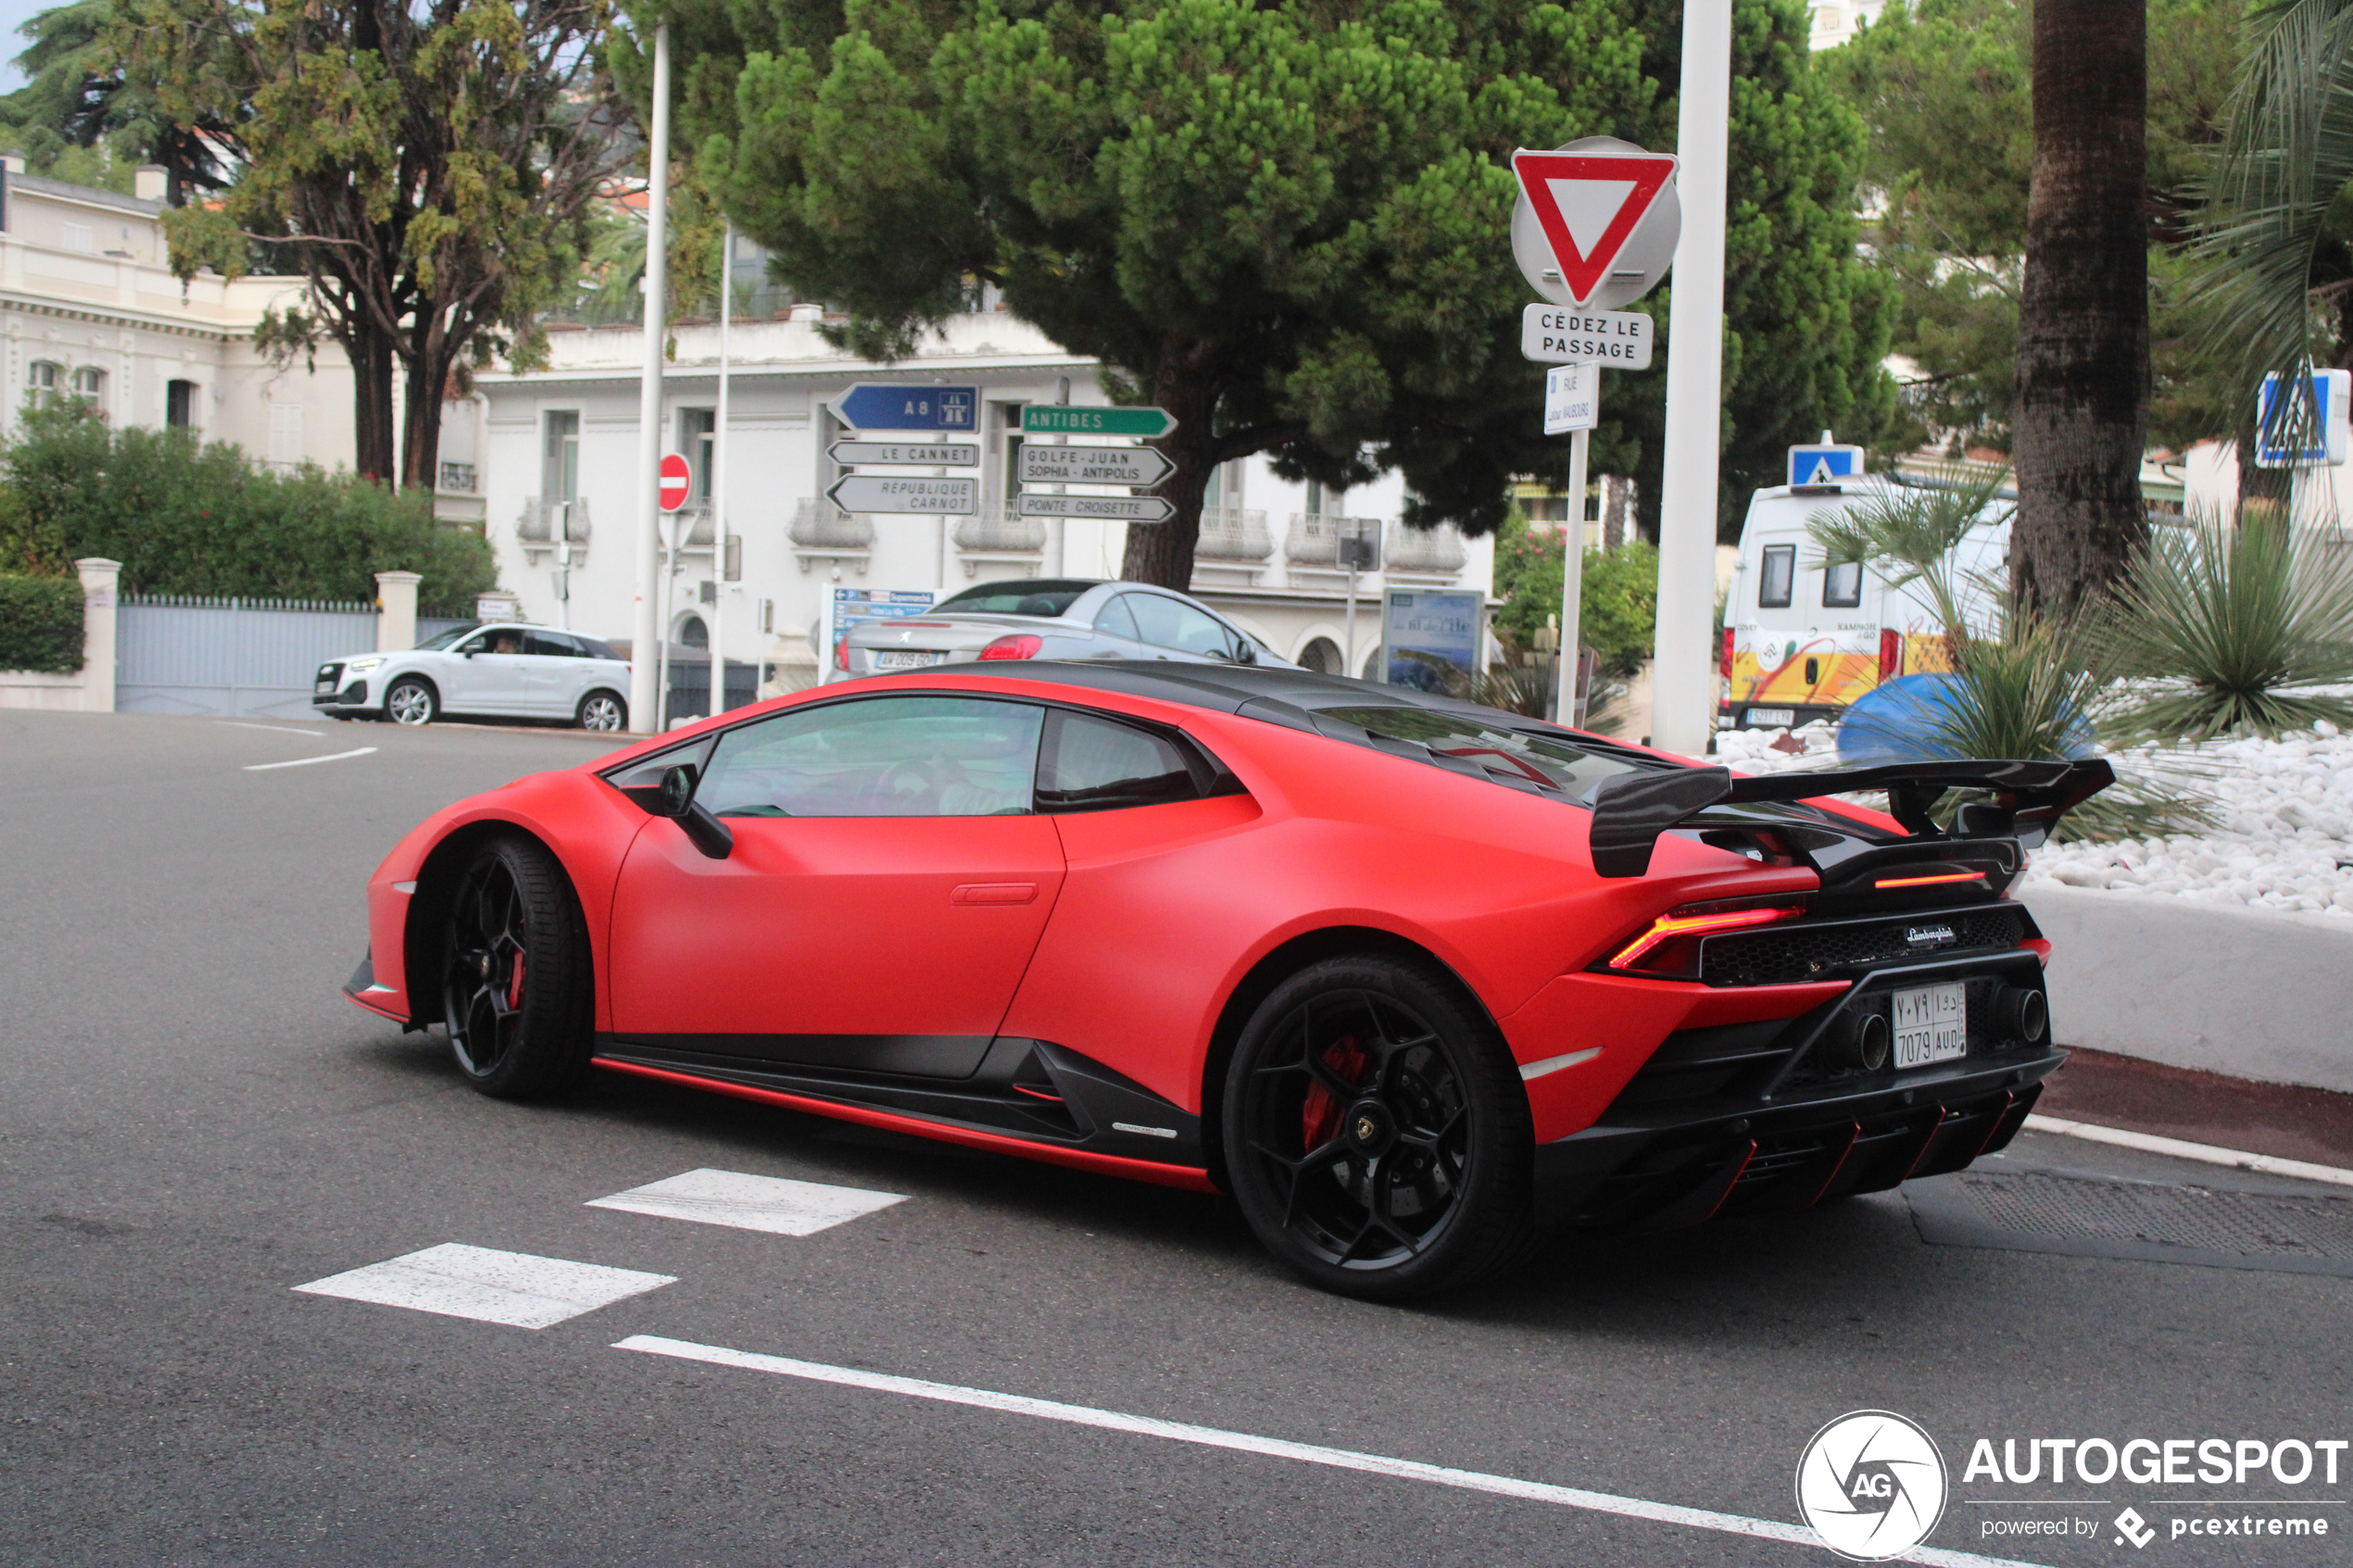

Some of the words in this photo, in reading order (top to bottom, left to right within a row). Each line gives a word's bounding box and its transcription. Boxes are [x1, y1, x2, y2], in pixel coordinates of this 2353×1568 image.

[1541, 312, 1607, 334] CÉDEZ
[1617, 321, 1639, 336] LE
[1543, 337, 1635, 358] PASSAGE
[1564, 376, 1578, 392] RUE
[1029, 412, 1102, 429] ANTIBES
[882, 448, 898, 460] LE
[909, 449, 969, 461] CANNET
[1082, 467, 1139, 480] ANTIPOLIS
[882, 480, 968, 495] RÉPUBLIQUE
[911, 497, 968, 510] CARNOT
[1026, 499, 1067, 512] POINTE
[1075, 501, 1140, 515] CROISETTE
[1906, 926, 1955, 942] Lamborghini
[1898, 1031, 1931, 1064] 7079
[1936, 1029, 1957, 1050] AUD
